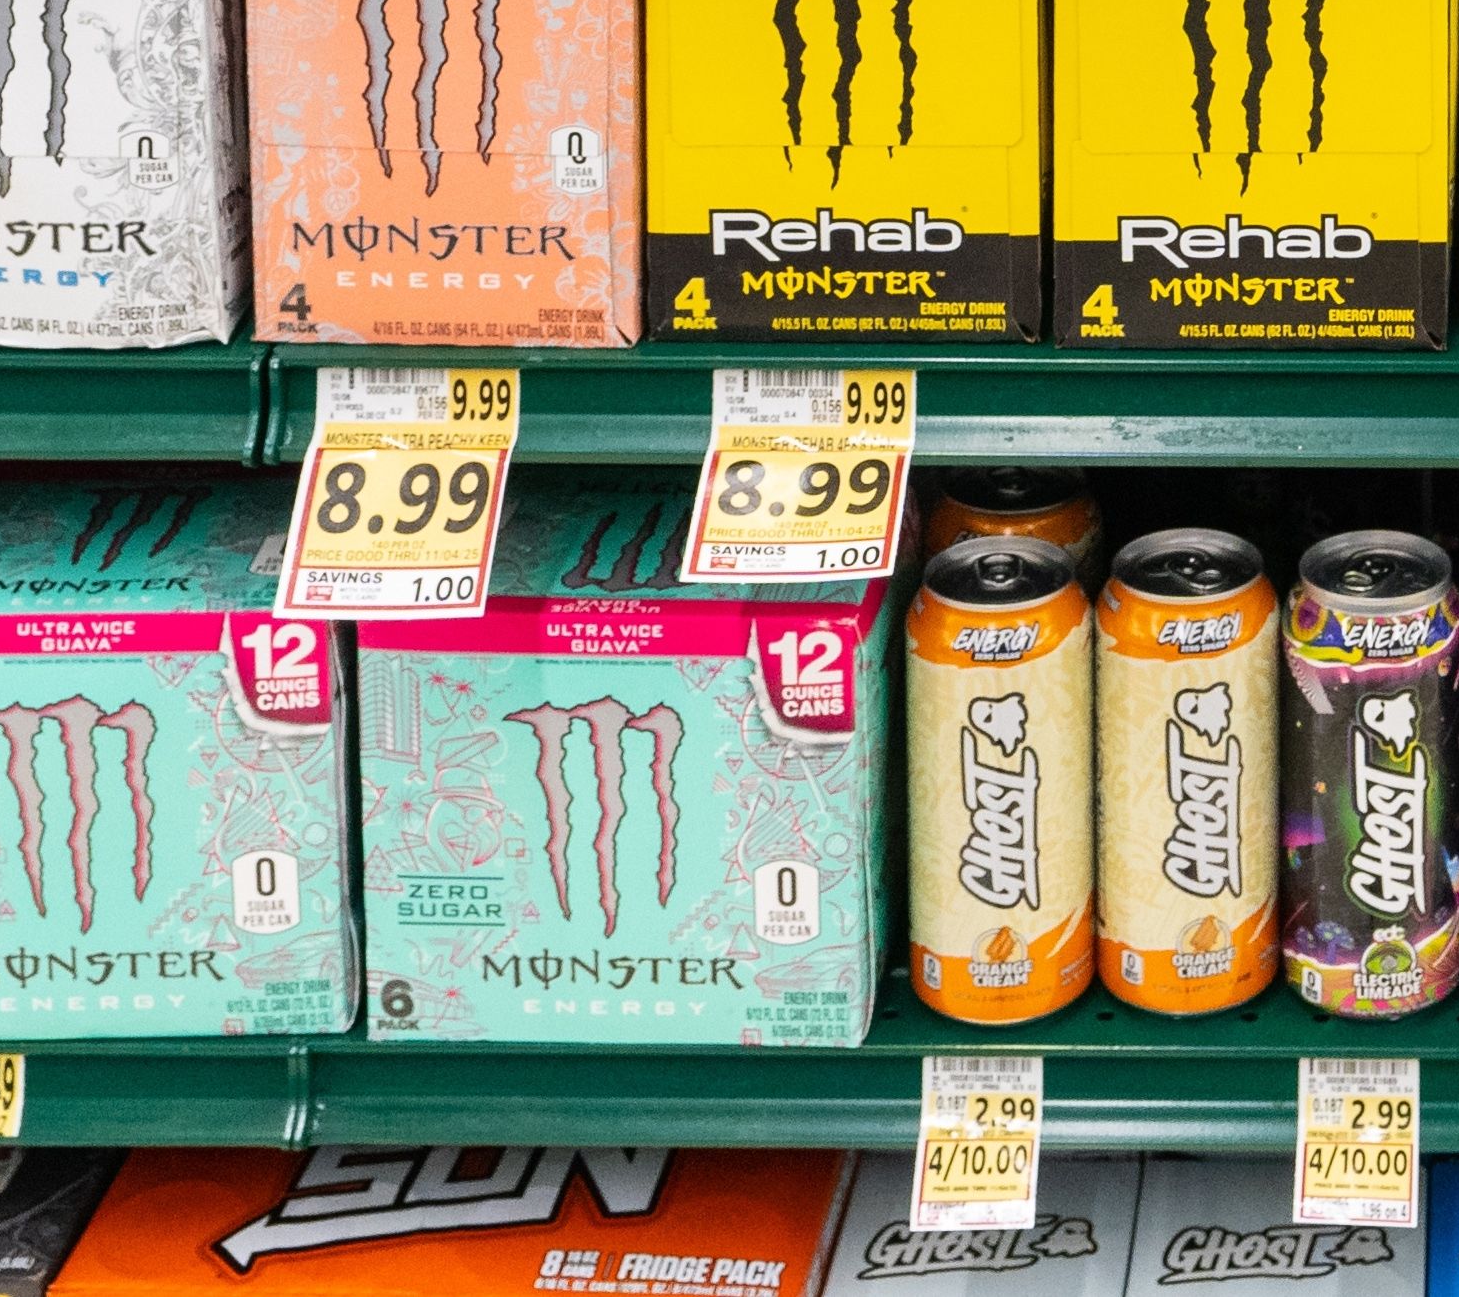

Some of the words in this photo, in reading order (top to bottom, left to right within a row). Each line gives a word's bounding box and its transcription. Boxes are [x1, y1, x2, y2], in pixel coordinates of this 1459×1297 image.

[1121, 214, 1372, 267] Rehab
[1081, 284, 1118, 325] 4
[1328, 308, 1375, 322] ENERGY
[1377, 308, 1415, 322] DRINK
[1080, 323, 1125, 338] PACK
[811, 399, 841, 413] 0.156
[846, 381, 906, 425] 9.99
[710, 544, 785, 558] SAVINGS
[816, 545, 881, 568] 1.00
[17, 622, 80, 636] ULTRA
[89, 620, 135, 636] VICE
[41, 637, 110, 651] GUAVA
[961, 733, 1040, 909] GHOST
[1307, 1149, 1408, 1179] 4/10.00
[1162, 1225, 1318, 1285] GHOST
[619, 1256, 710, 1283] FRIDGE
[717, 1260, 784, 1288] PACK
